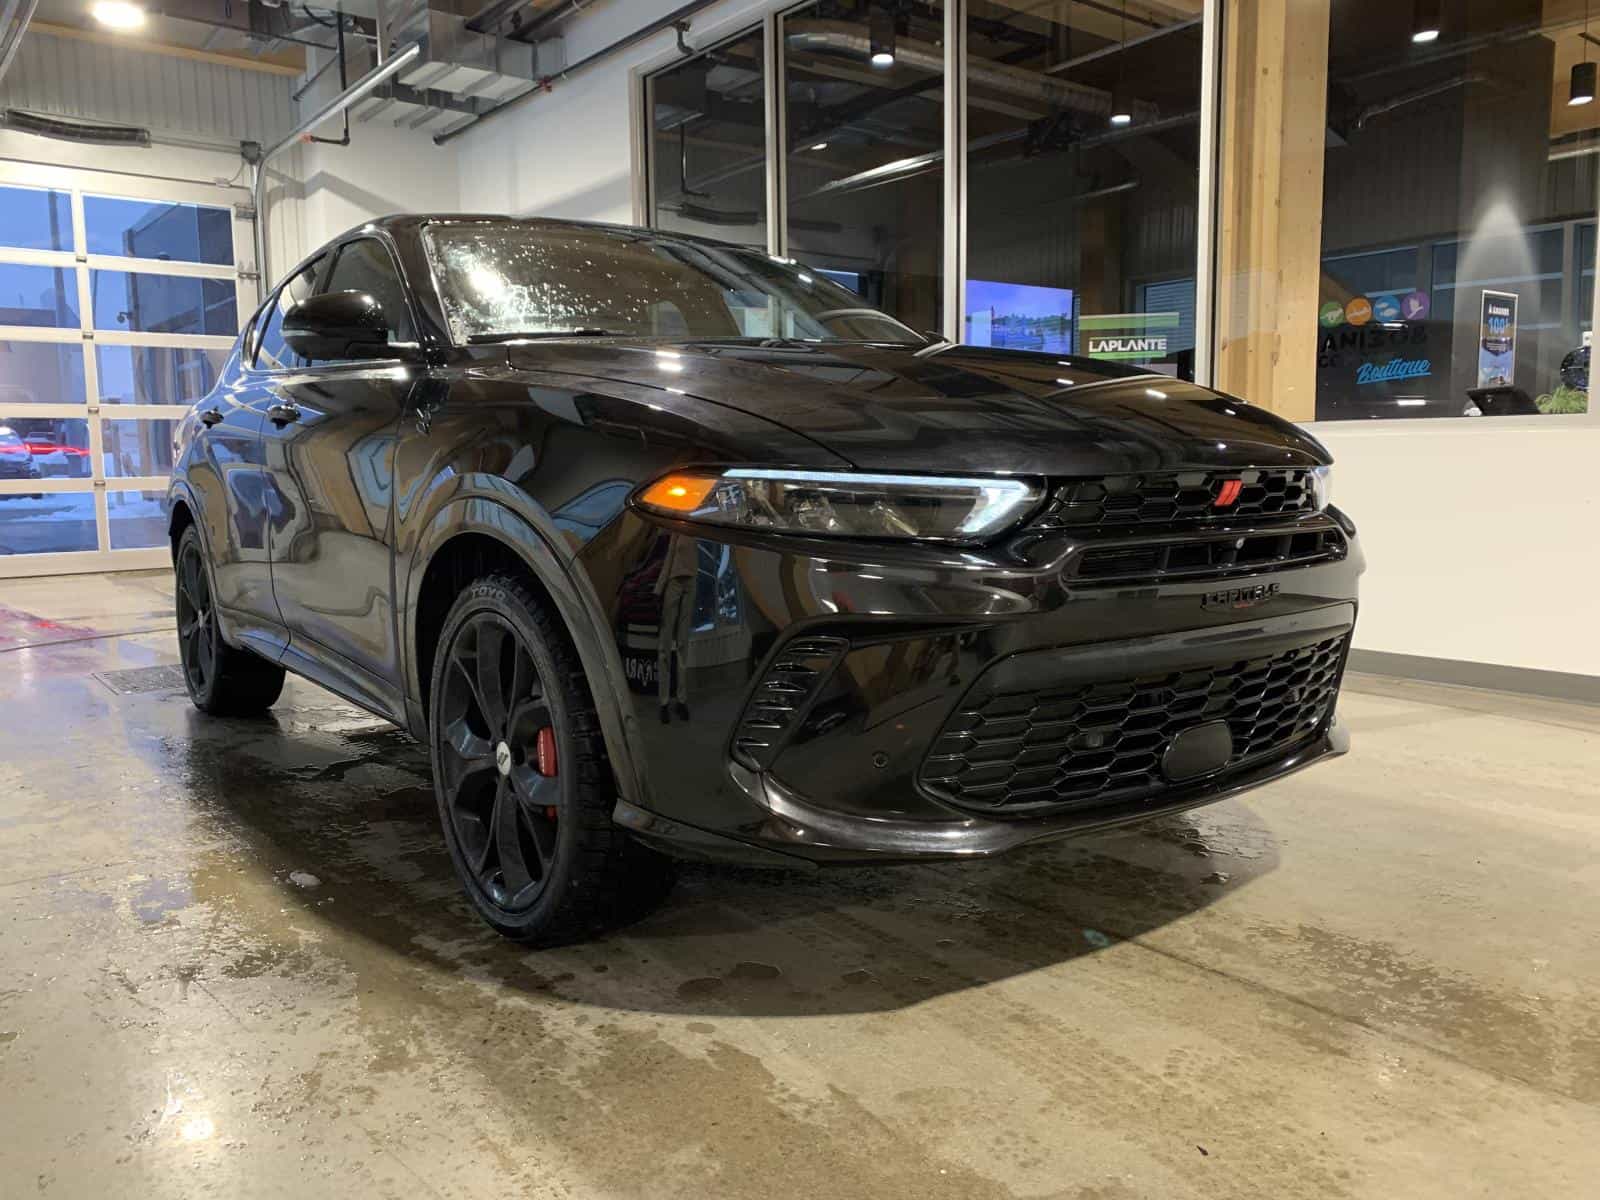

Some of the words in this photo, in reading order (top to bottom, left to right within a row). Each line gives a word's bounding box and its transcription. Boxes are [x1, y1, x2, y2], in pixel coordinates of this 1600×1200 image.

[1088, 338, 1167, 352] LAPLANTE
[1356, 358, 1432, 385] Boutique
[471, 586, 506, 600] TOYO
